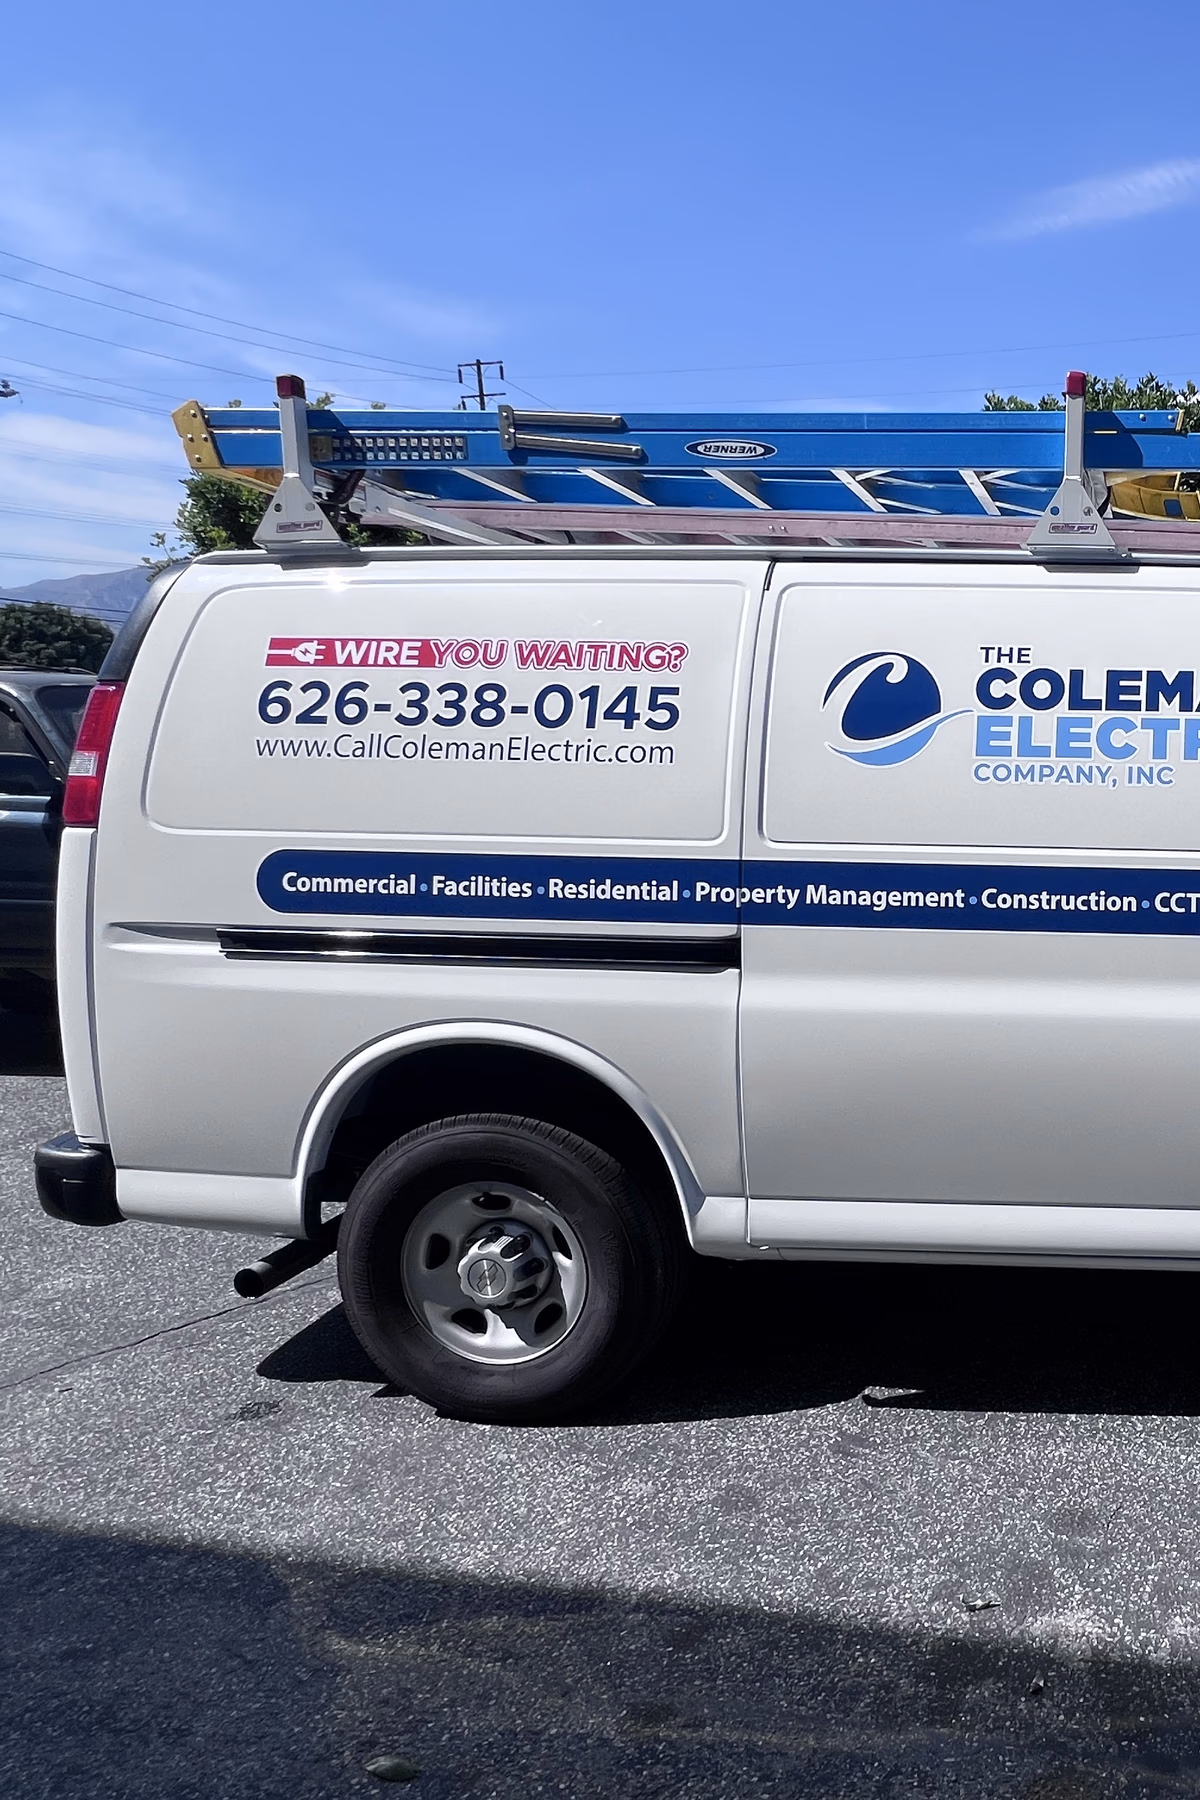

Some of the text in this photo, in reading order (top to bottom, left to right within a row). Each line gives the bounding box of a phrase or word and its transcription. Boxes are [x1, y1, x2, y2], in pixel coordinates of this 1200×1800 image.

[703, 444, 757, 454] WERNER
[334, 639, 688, 673] WIRE YOU WAITING?
[980, 647, 1031, 664] THE
[258, 680, 680, 730] 626-338-0145
[256, 733, 675, 765] www.CallColemanElectric.com
[974, 763, 1174, 788] COMPANY, INC
[282, 872, 415, 895] Commercial
[432, 876, 532, 898] Facilities
[548, 879, 678, 901] Residential
[695, 882, 800, 909] Property
[805, 885, 964, 911] Management
[981, 889, 1137, 912] Construction
